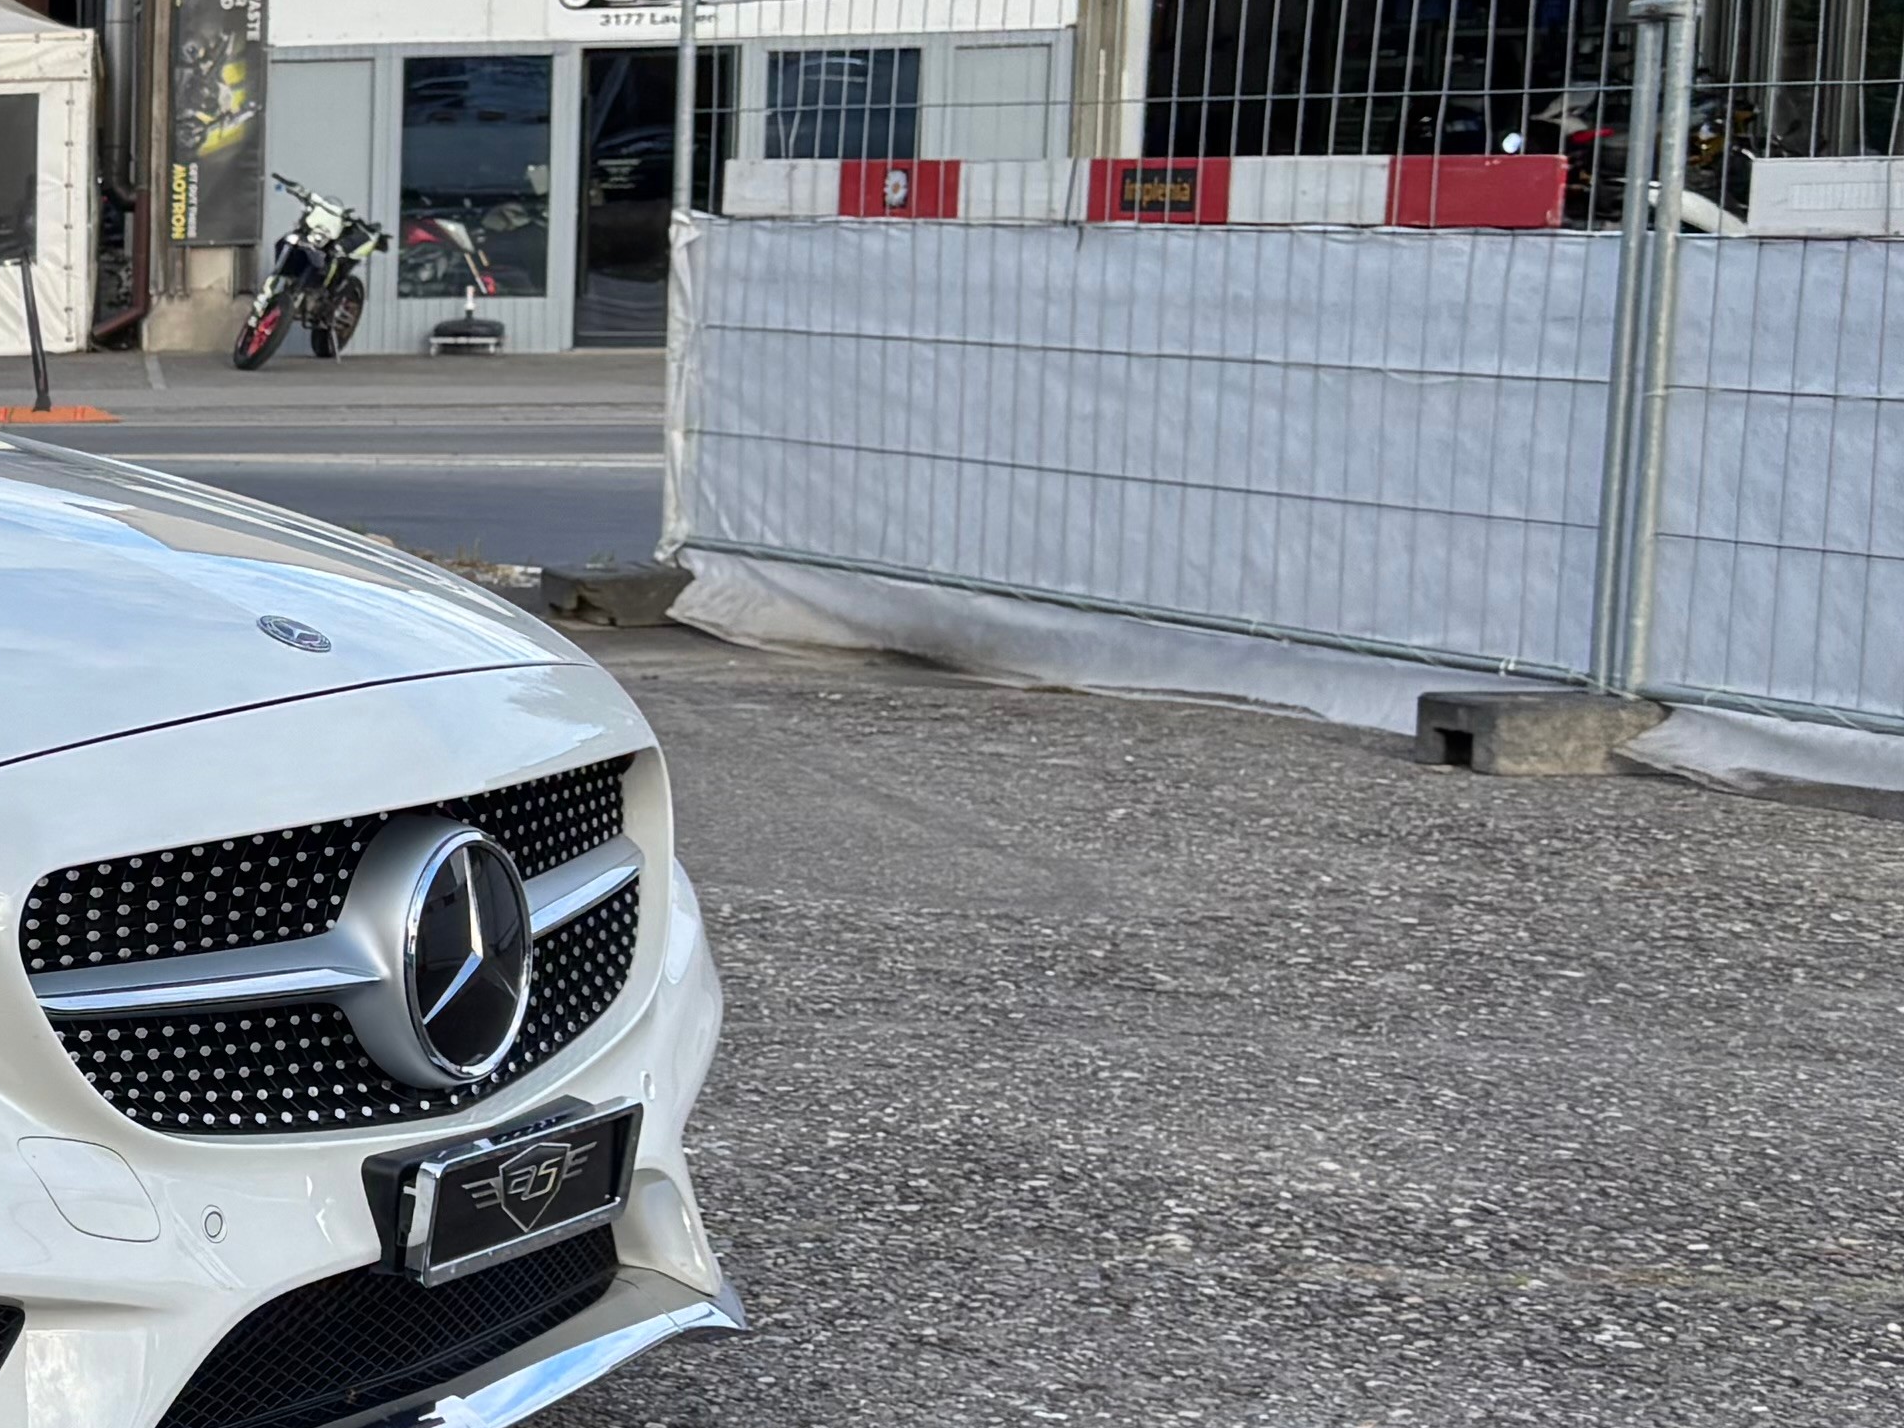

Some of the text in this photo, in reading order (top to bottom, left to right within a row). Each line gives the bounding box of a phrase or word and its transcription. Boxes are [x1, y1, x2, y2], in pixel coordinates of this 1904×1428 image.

[599, 13, 718, 27] 3177 Lauen
[171, 163, 187, 240] MOTRON
